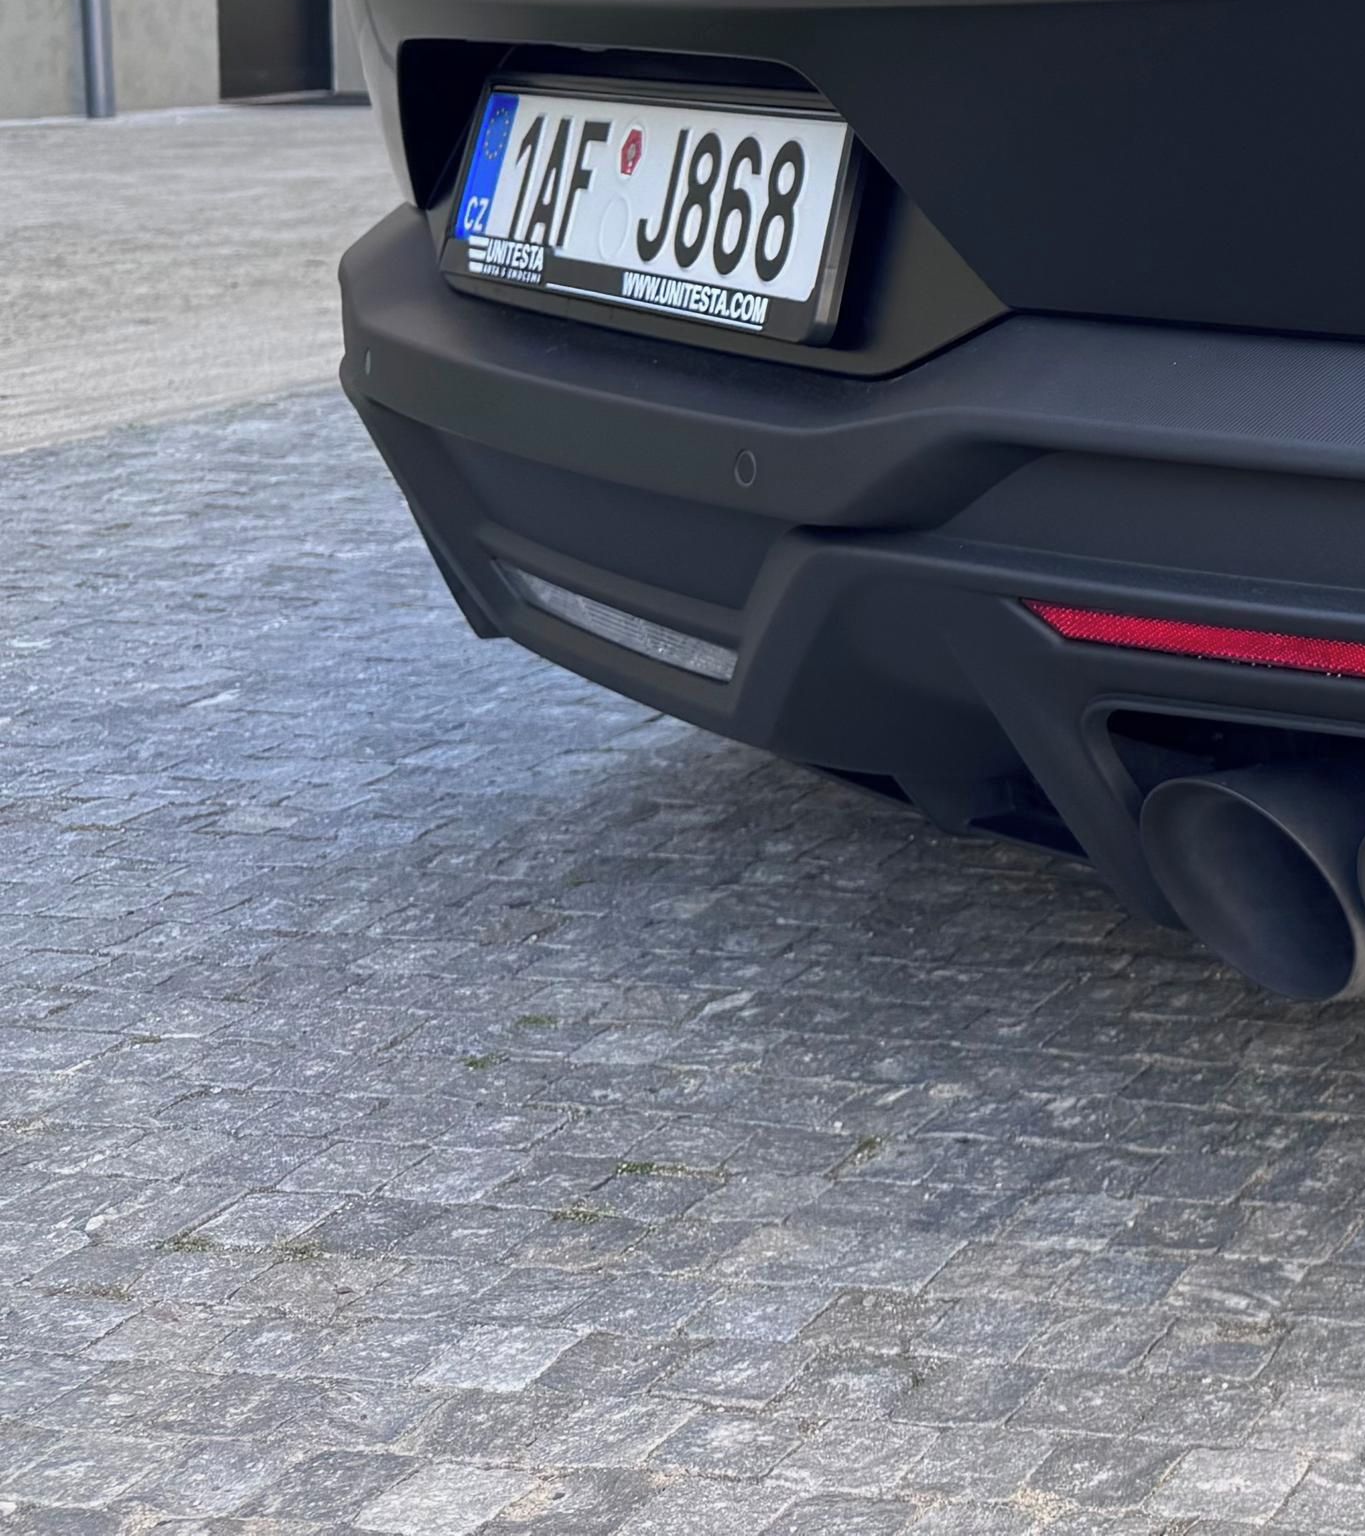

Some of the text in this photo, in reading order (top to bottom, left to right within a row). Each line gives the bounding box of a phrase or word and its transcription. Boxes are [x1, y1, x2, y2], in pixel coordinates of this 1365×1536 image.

[464, 197, 489, 231] CZ
[510, 116, 805, 282] 1AF J868
[486, 239, 544, 272] UNITESTA
[622, 272, 768, 323] WWW.UNITESTA.COM
